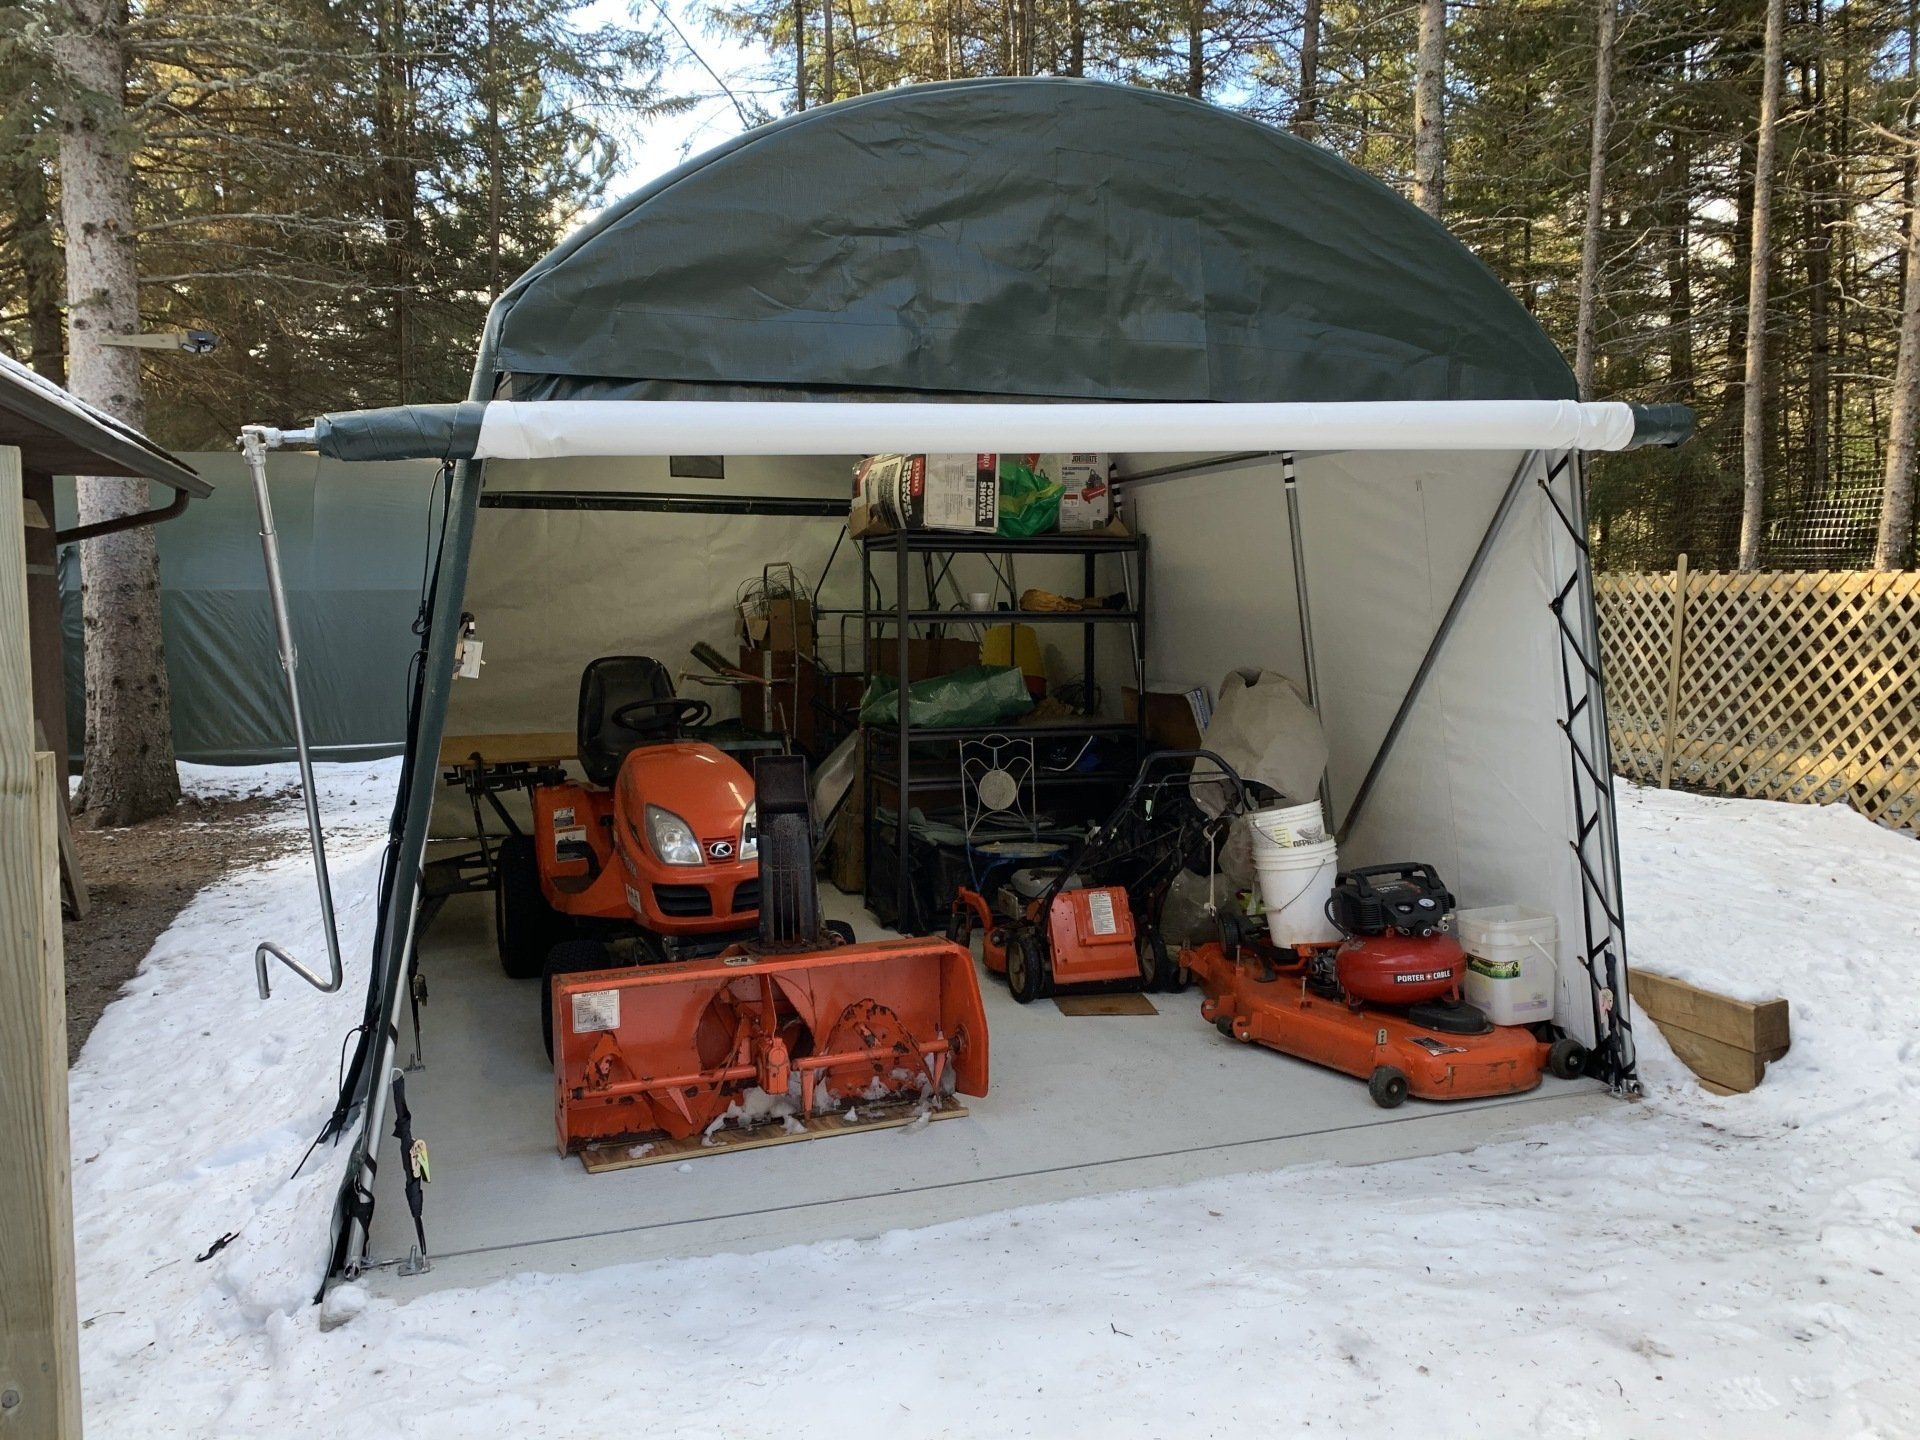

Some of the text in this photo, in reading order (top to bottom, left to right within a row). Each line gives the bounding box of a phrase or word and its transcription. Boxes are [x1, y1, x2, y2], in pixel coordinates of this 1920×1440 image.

[914, 460, 922, 492] TORO
[979, 481, 987, 521] SHOVEL
[986, 481, 994, 519] POWER
[1397, 970, 1451, 982] PORTER CABLE
